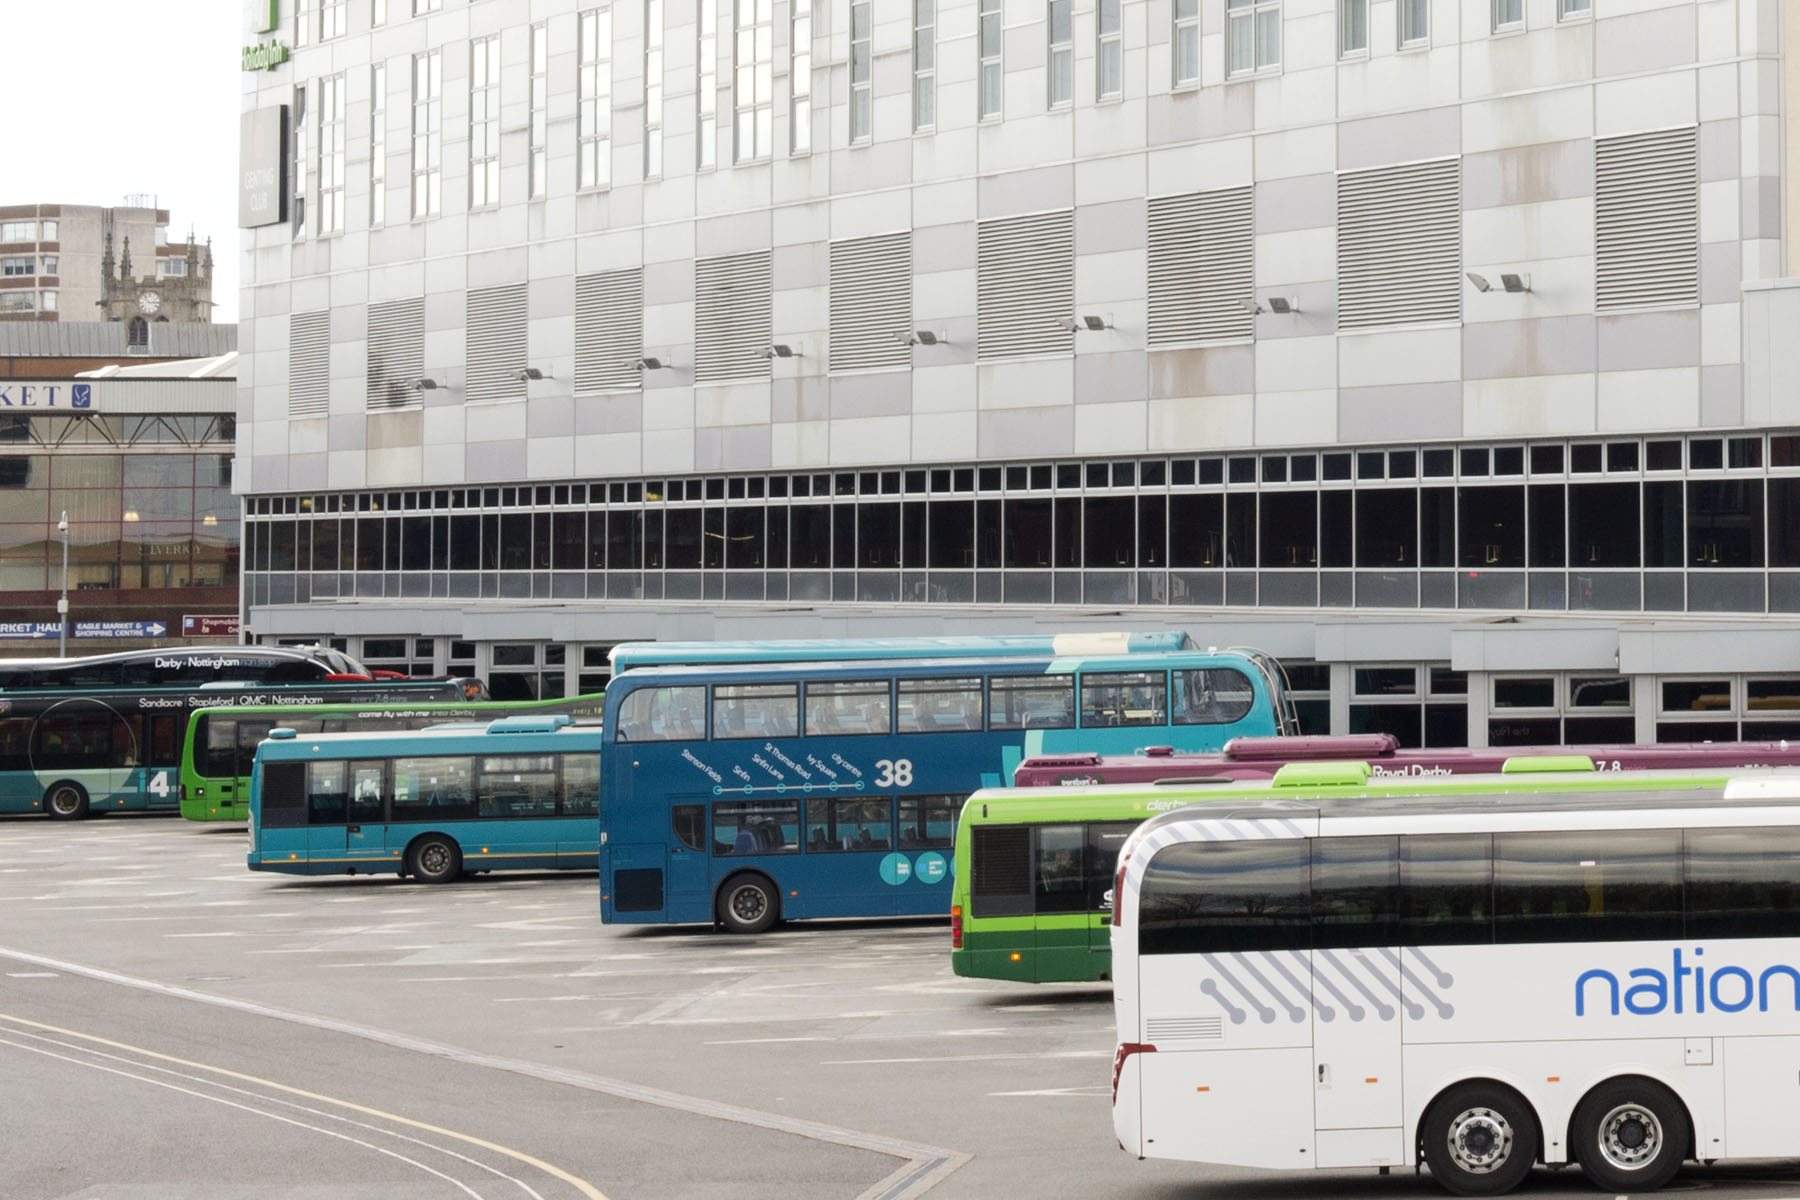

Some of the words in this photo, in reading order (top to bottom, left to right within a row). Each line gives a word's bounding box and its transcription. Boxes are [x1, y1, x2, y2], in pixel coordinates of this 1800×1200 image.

[0, 385, 61, 407] KET
[155, 657, 182, 669] Derby
[187, 656, 239, 669] Nottingham
[139, 698, 183, 708] Sandiacre
[188, 696, 234, 707] Stapleford
[272, 694, 323, 705] Nottingham
[383, 710, 395, 719] fly
[681, 748, 706, 770] Stenson
[704, 766, 722, 783] Fields
[752, 753, 770, 770] Sinfin
[768, 765, 784, 780] Lane
[764, 742, 773, 752] St
[772, 747, 796, 769] Thomas
[794, 764, 812, 780] Road
[815, 760, 837, 779] Square
[842, 761, 862, 778] centre
[732, 765, 751, 782] Sinfin
[874, 759, 913, 788] 38
[1411, 764, 1452, 777] Derby
